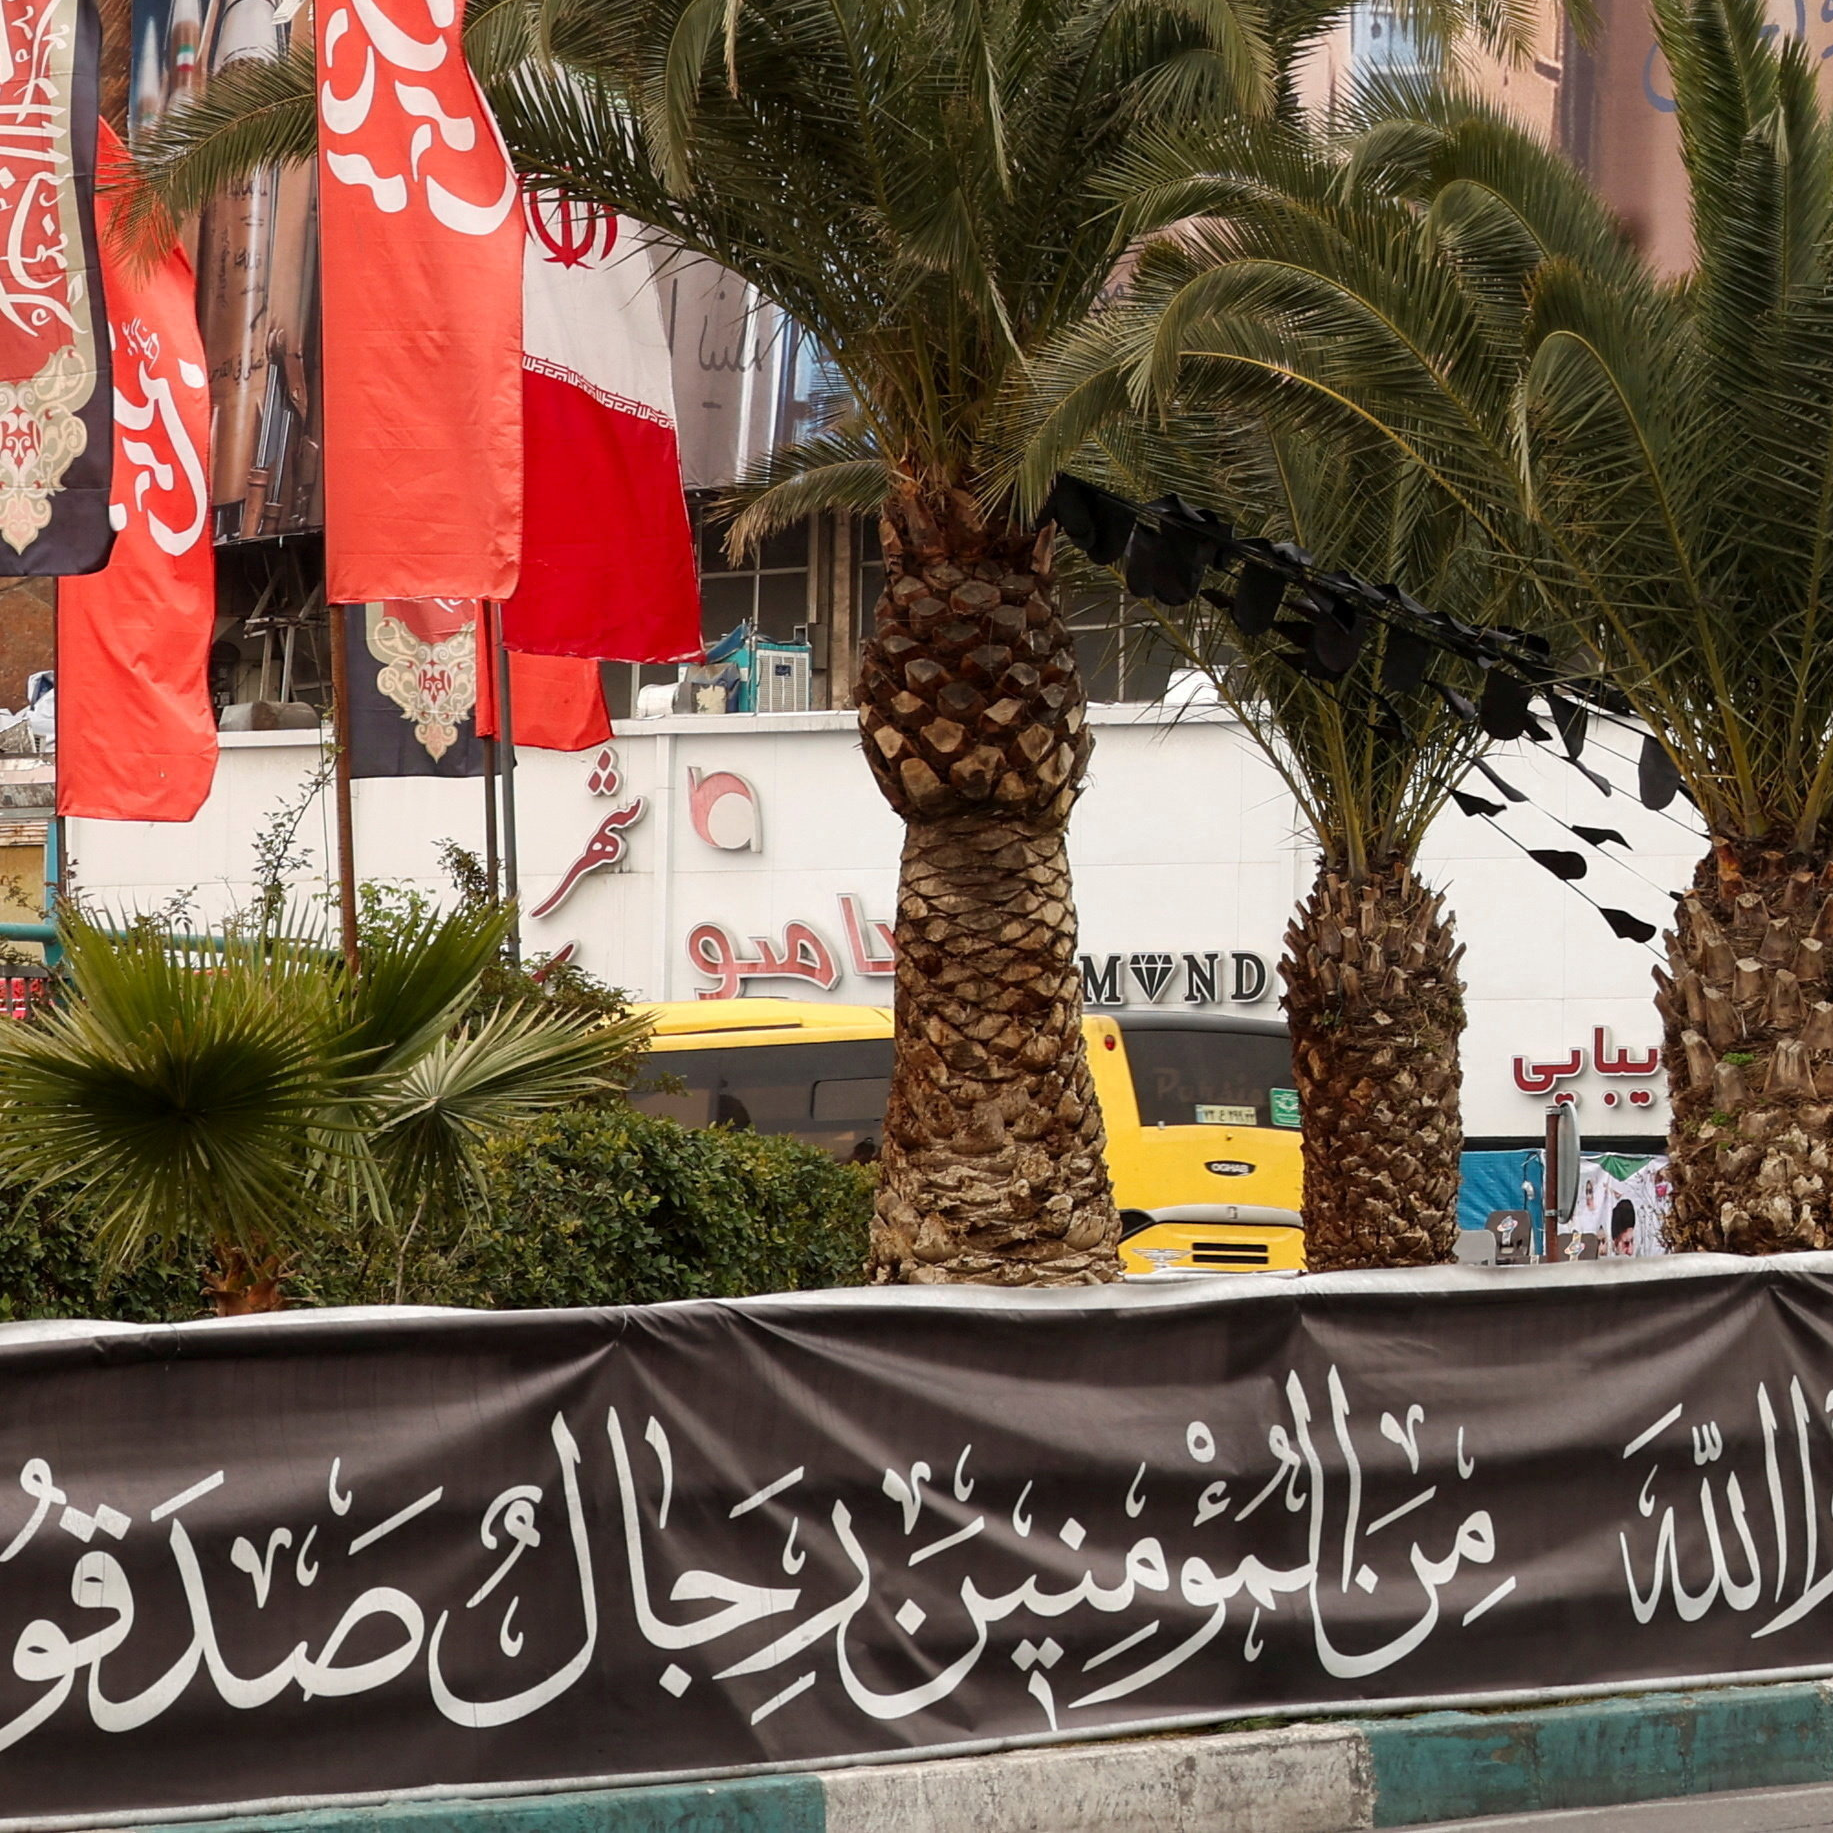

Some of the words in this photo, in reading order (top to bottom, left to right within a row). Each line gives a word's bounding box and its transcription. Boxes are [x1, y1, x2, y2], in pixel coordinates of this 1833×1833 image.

[529, 747, 649, 920] شهر
[1511, 1024, 1662, 1111] یبایی
[1210, 1159, 1250, 1175] OGHAB
